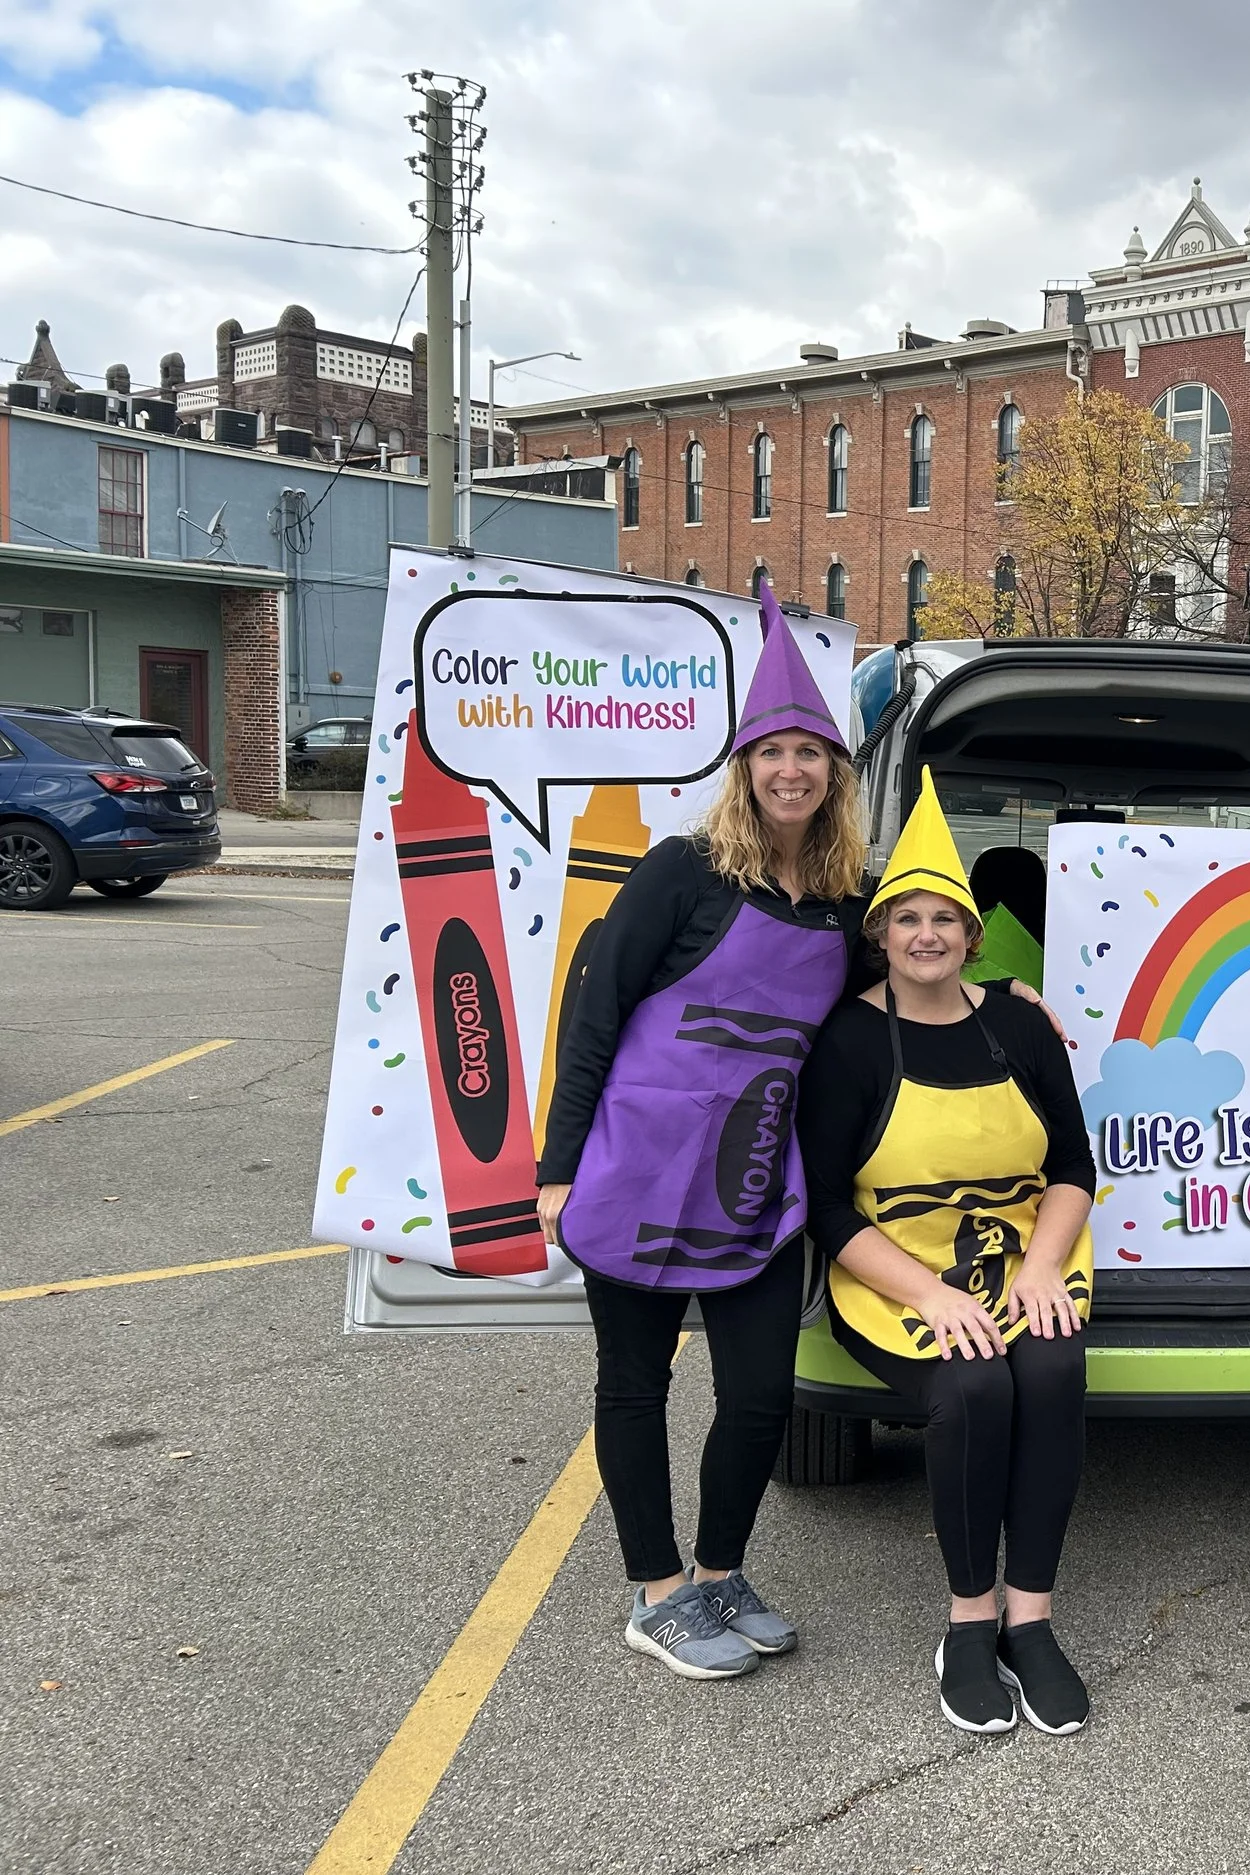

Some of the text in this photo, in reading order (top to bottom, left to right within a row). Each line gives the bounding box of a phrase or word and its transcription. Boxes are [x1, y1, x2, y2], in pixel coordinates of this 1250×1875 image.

[1179, 240, 1204, 256] 1890
[432, 648, 716, 689] Color Your World
[546, 694, 695, 730] Kindness!
[452, 972, 490, 1098] Crayons
[733, 1079, 789, 1217] CRAYON
[1107, 1114, 1204, 1169] Life
[1189, 1177, 1229, 1228] in
[967, 1217, 1004, 1309] CRO
